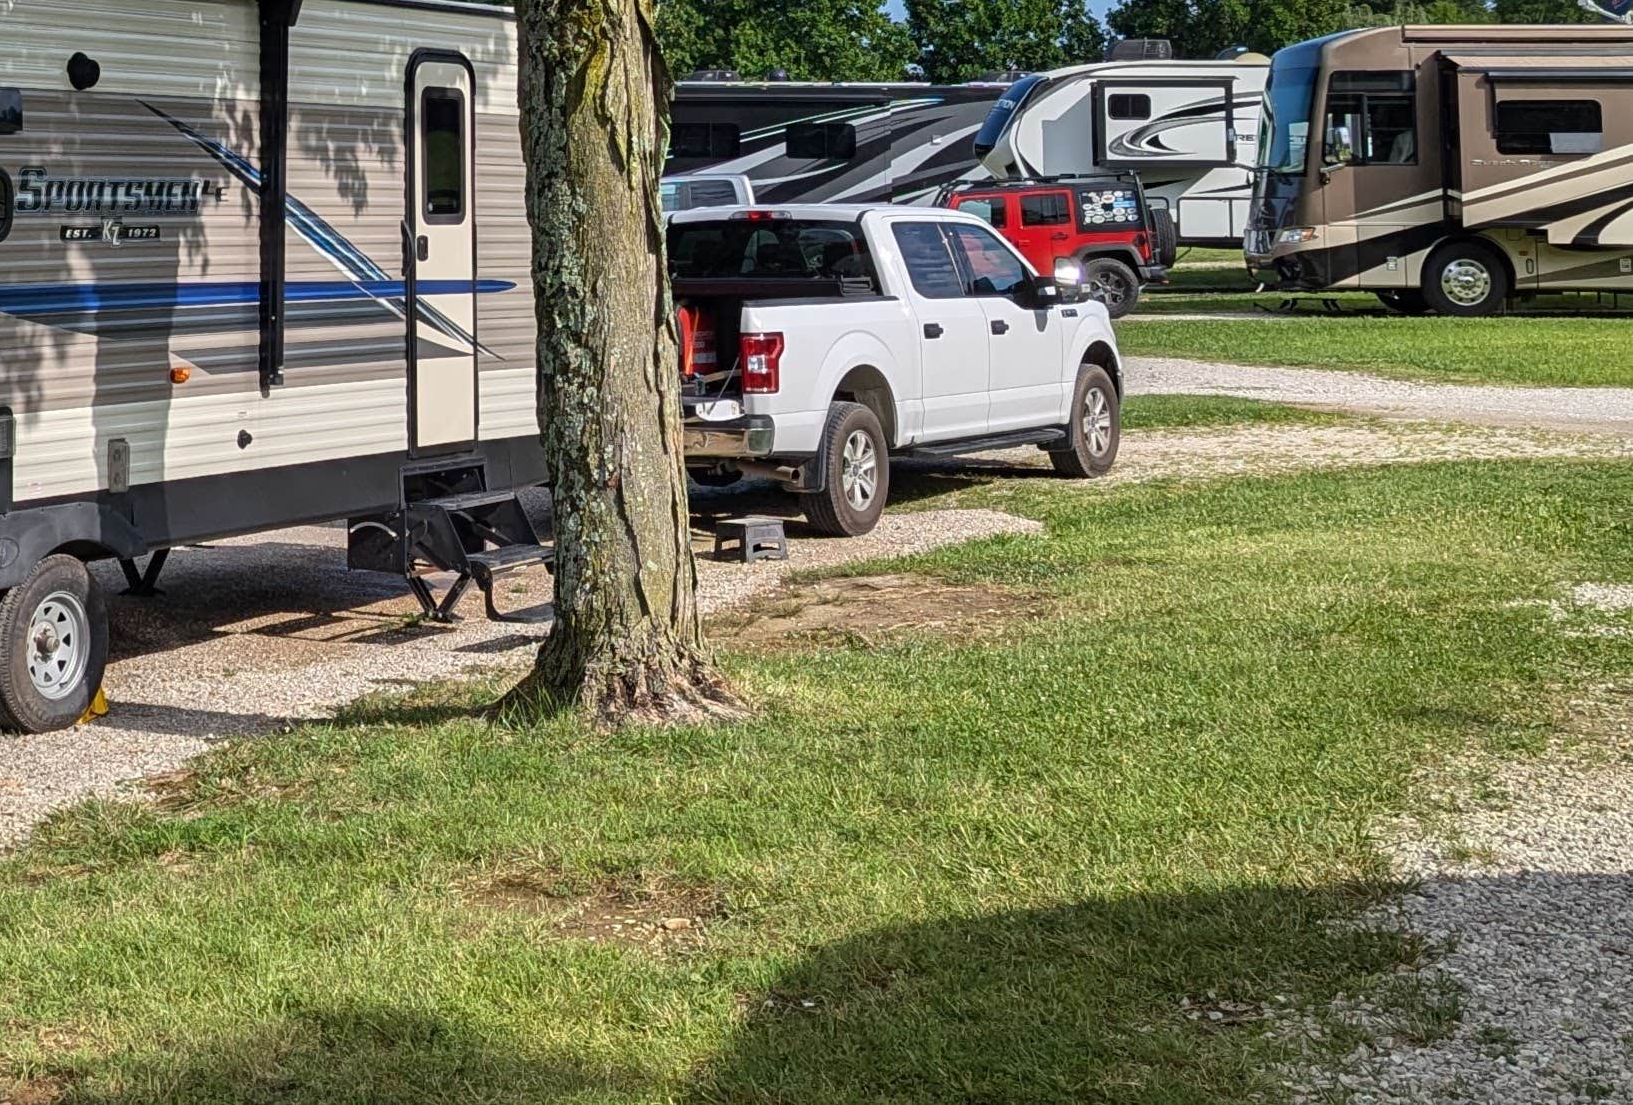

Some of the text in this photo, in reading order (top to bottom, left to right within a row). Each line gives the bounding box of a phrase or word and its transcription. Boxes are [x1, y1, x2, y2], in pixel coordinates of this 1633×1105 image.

[16, 166, 203, 215] SPORTSMEN
[66, 218, 156, 245] EST. KZ 1972
